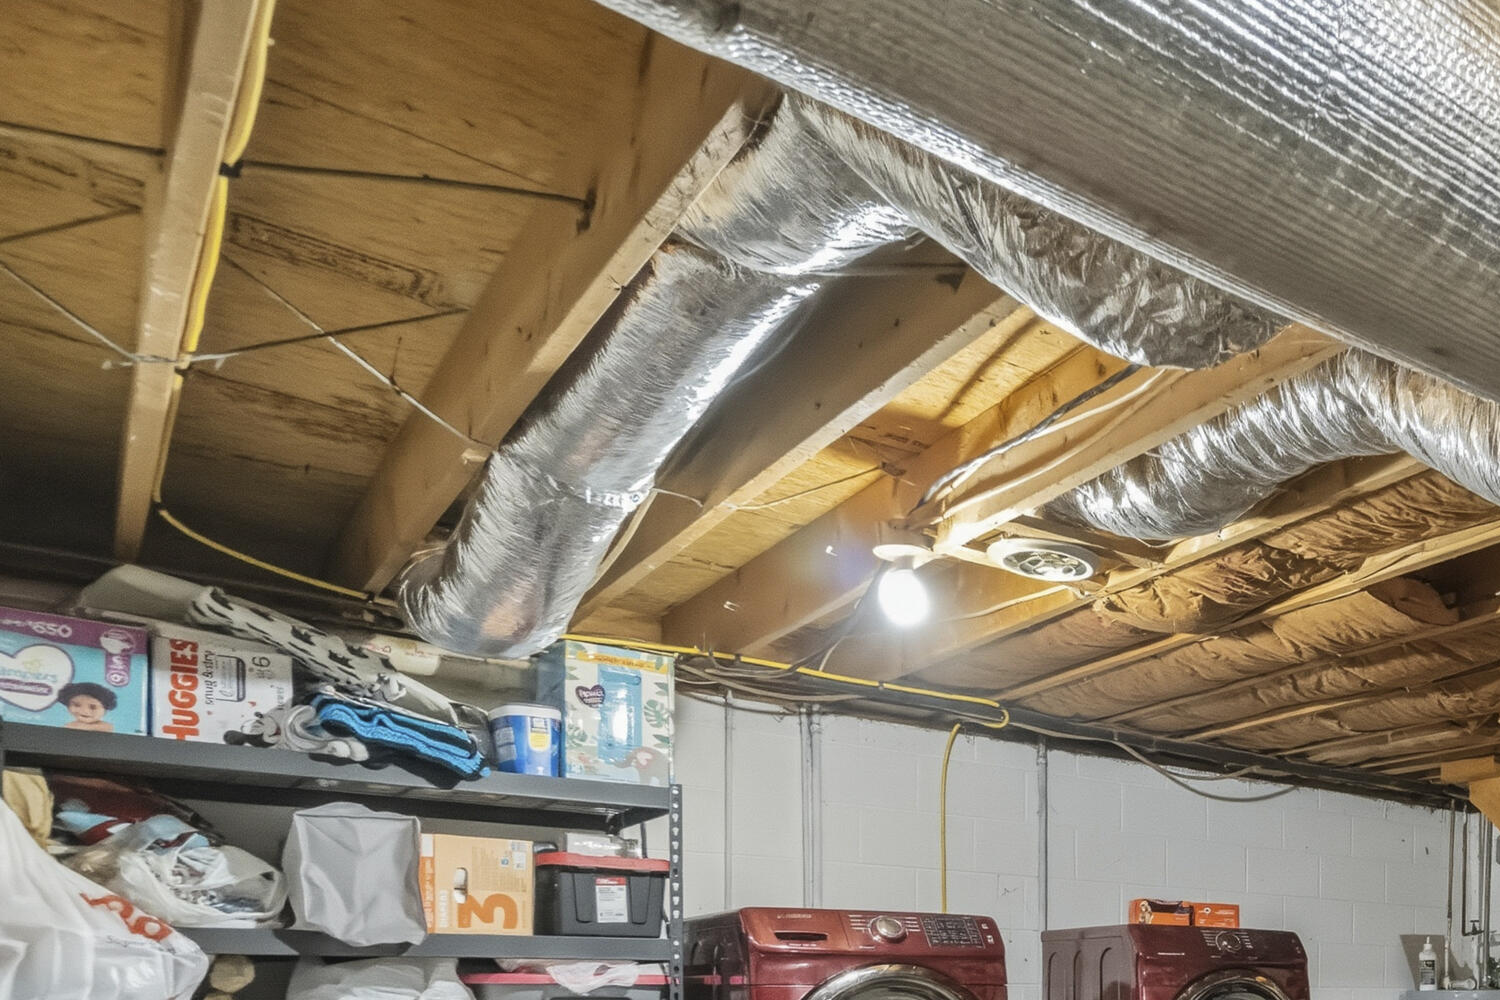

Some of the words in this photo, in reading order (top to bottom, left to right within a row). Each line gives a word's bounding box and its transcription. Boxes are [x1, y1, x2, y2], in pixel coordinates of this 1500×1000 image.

[251, 656, 271, 668] 6
[162, 638, 199, 741] HUGGIES
[457, 893, 519, 930] 3
